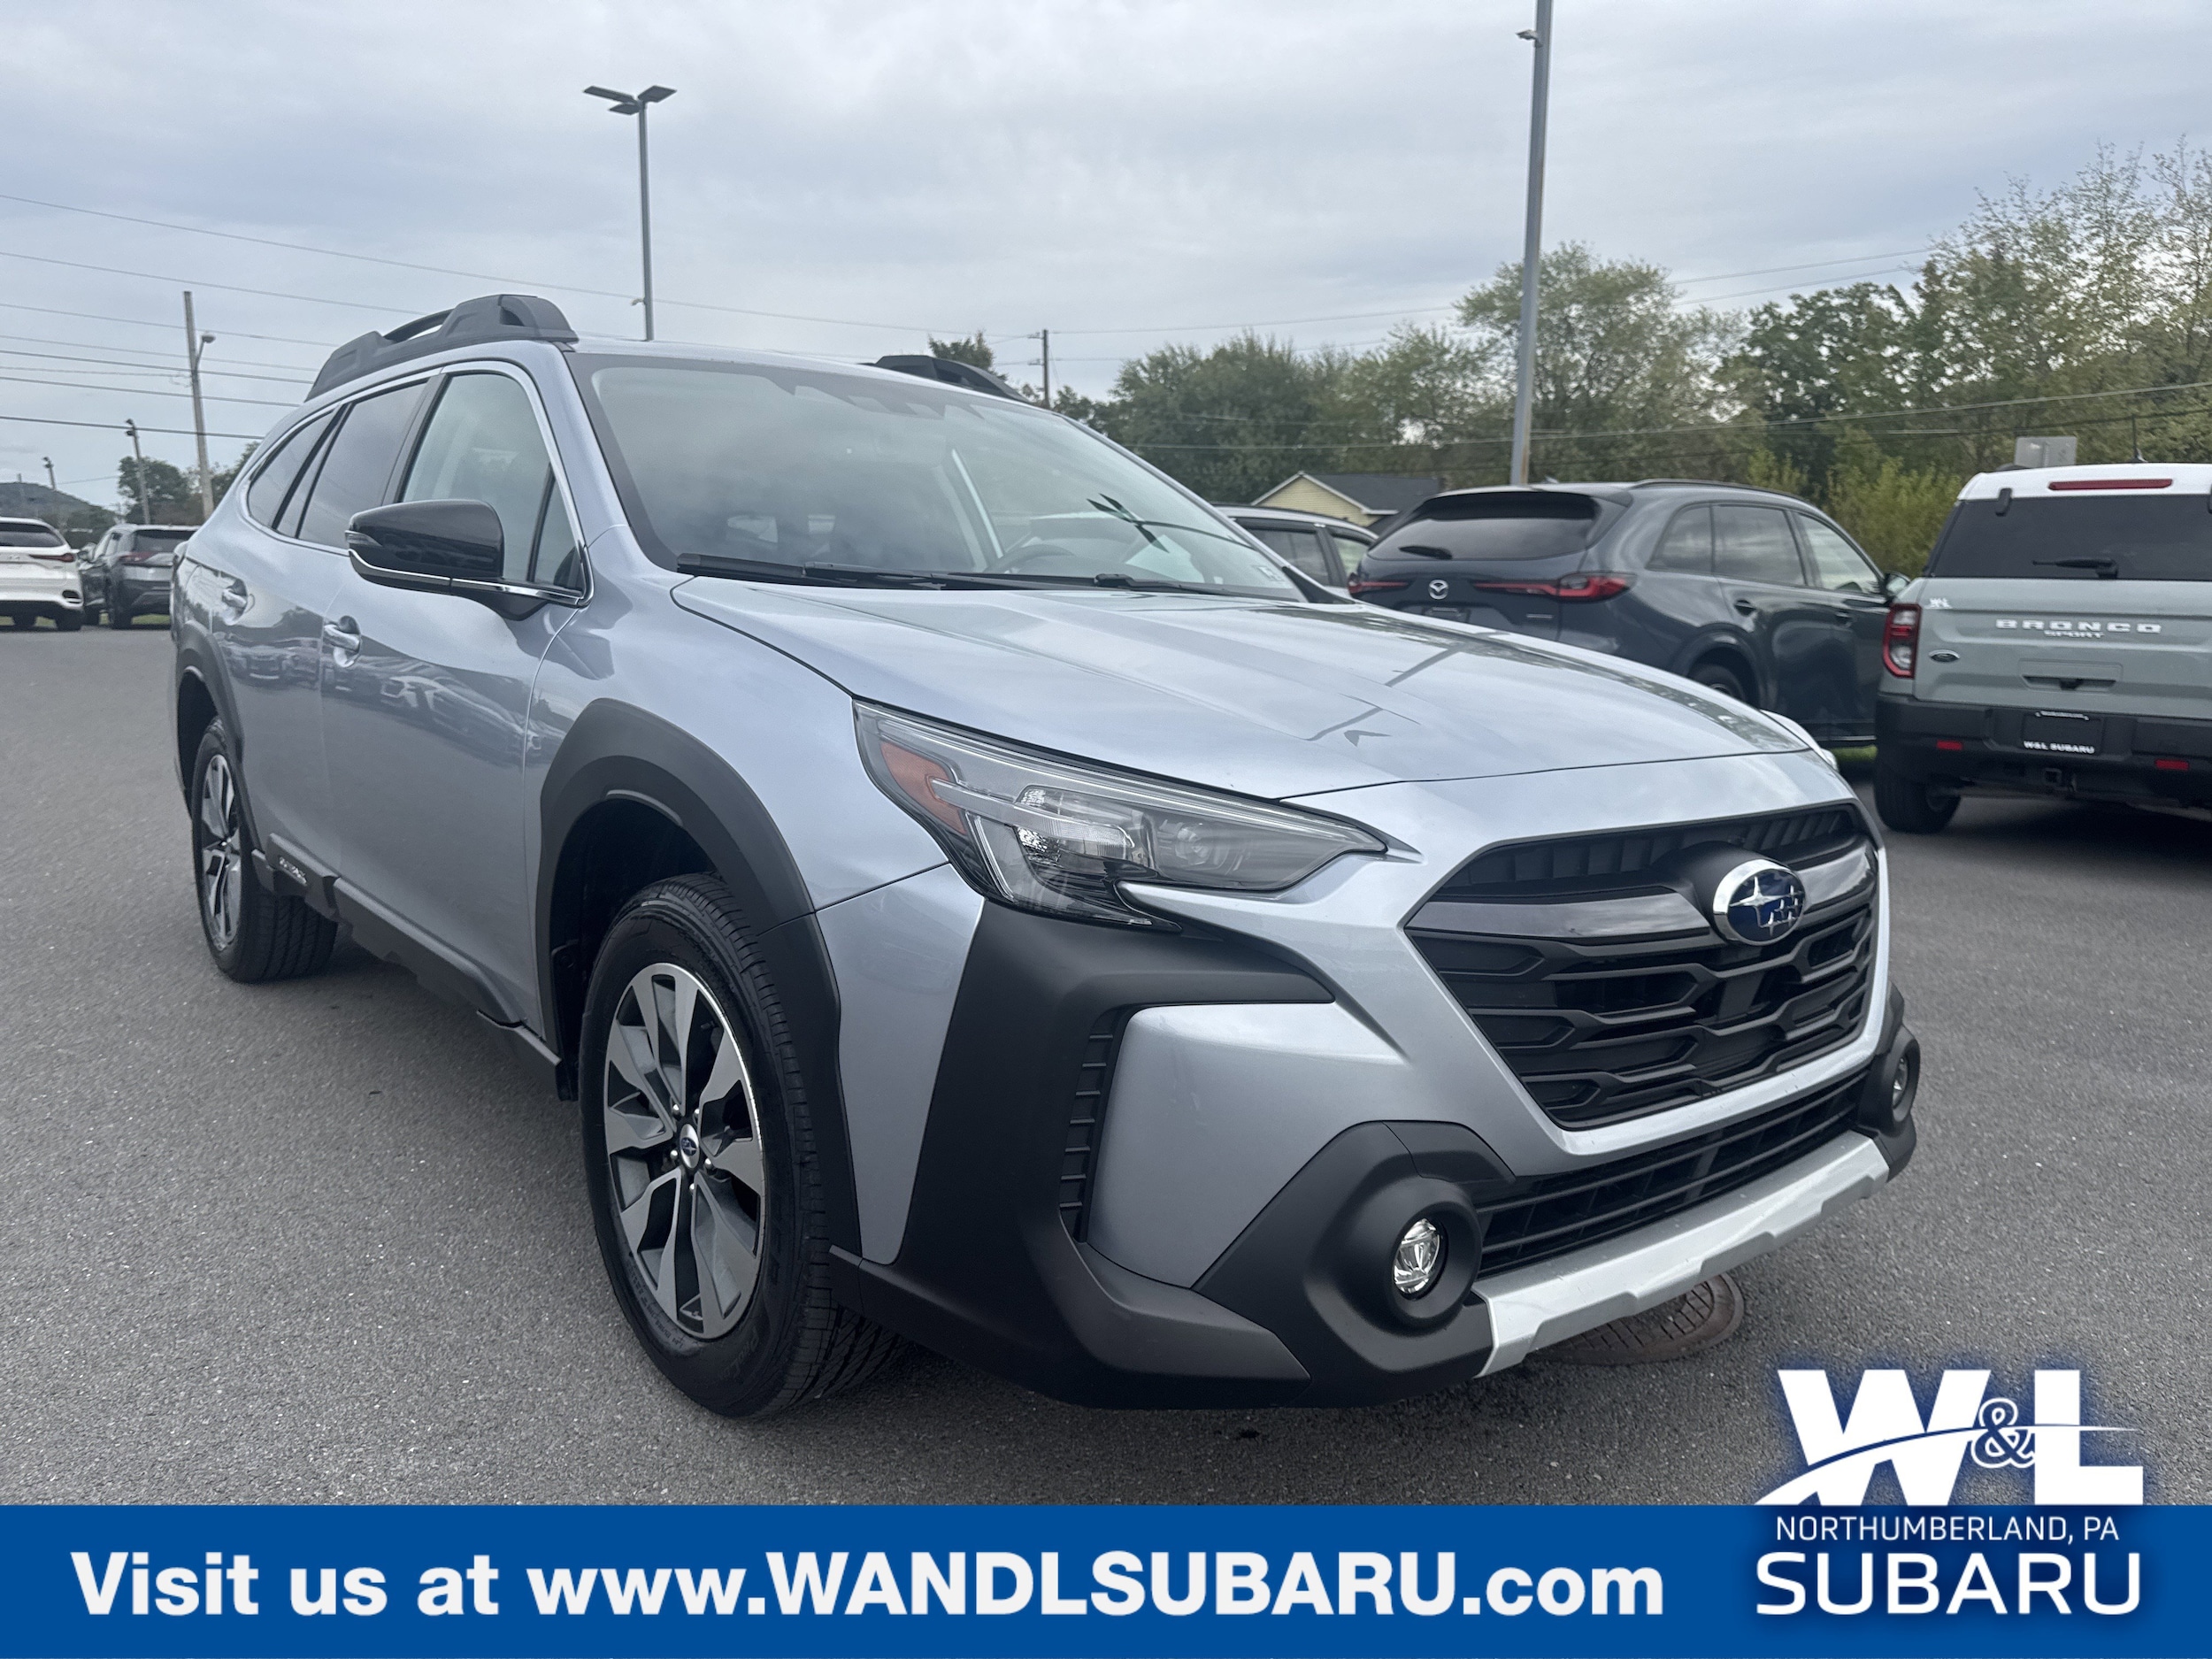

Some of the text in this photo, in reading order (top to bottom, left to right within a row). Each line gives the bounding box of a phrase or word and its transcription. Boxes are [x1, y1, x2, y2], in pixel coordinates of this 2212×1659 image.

[1995, 619, 2162, 634] BRONCO
[2044, 630, 2104, 639] SPORT
[2049, 743, 2095, 754] SUBARU
